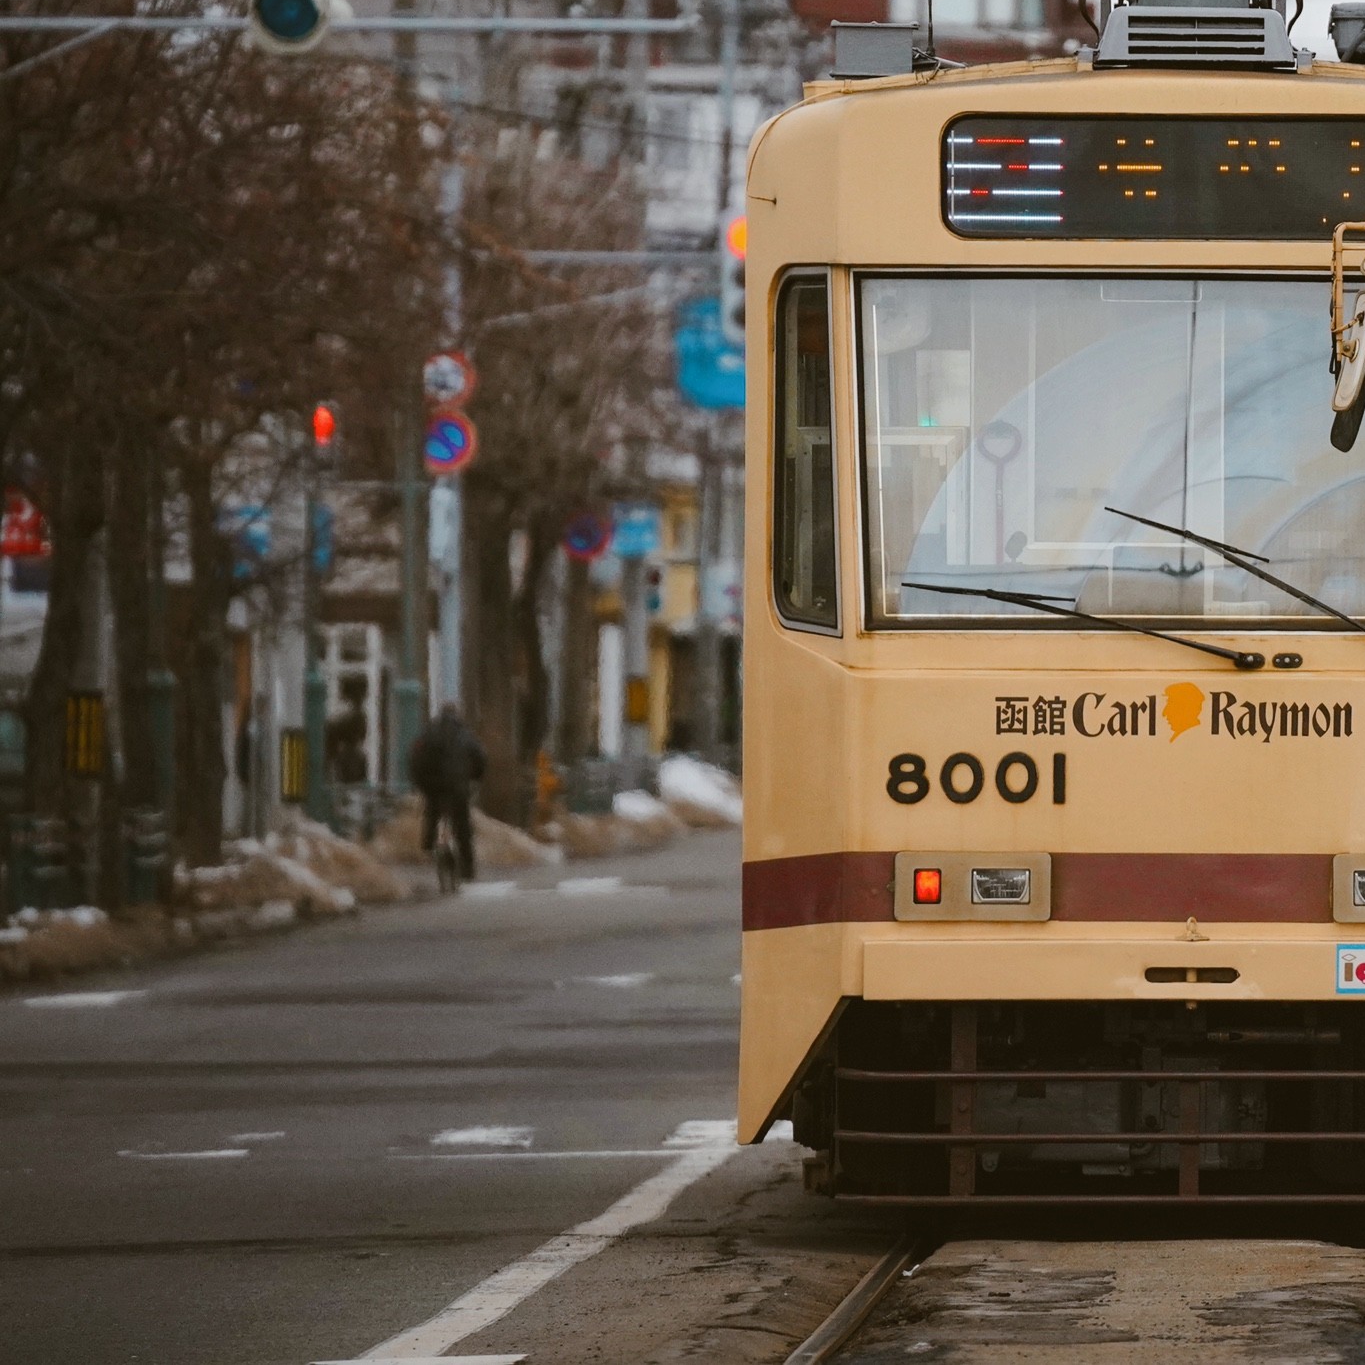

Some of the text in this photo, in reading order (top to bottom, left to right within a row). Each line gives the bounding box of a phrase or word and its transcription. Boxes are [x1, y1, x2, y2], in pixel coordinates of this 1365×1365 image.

[995, 691, 1353, 743] 函館 Carl Raymon
[886, 751, 1067, 805] 8001
